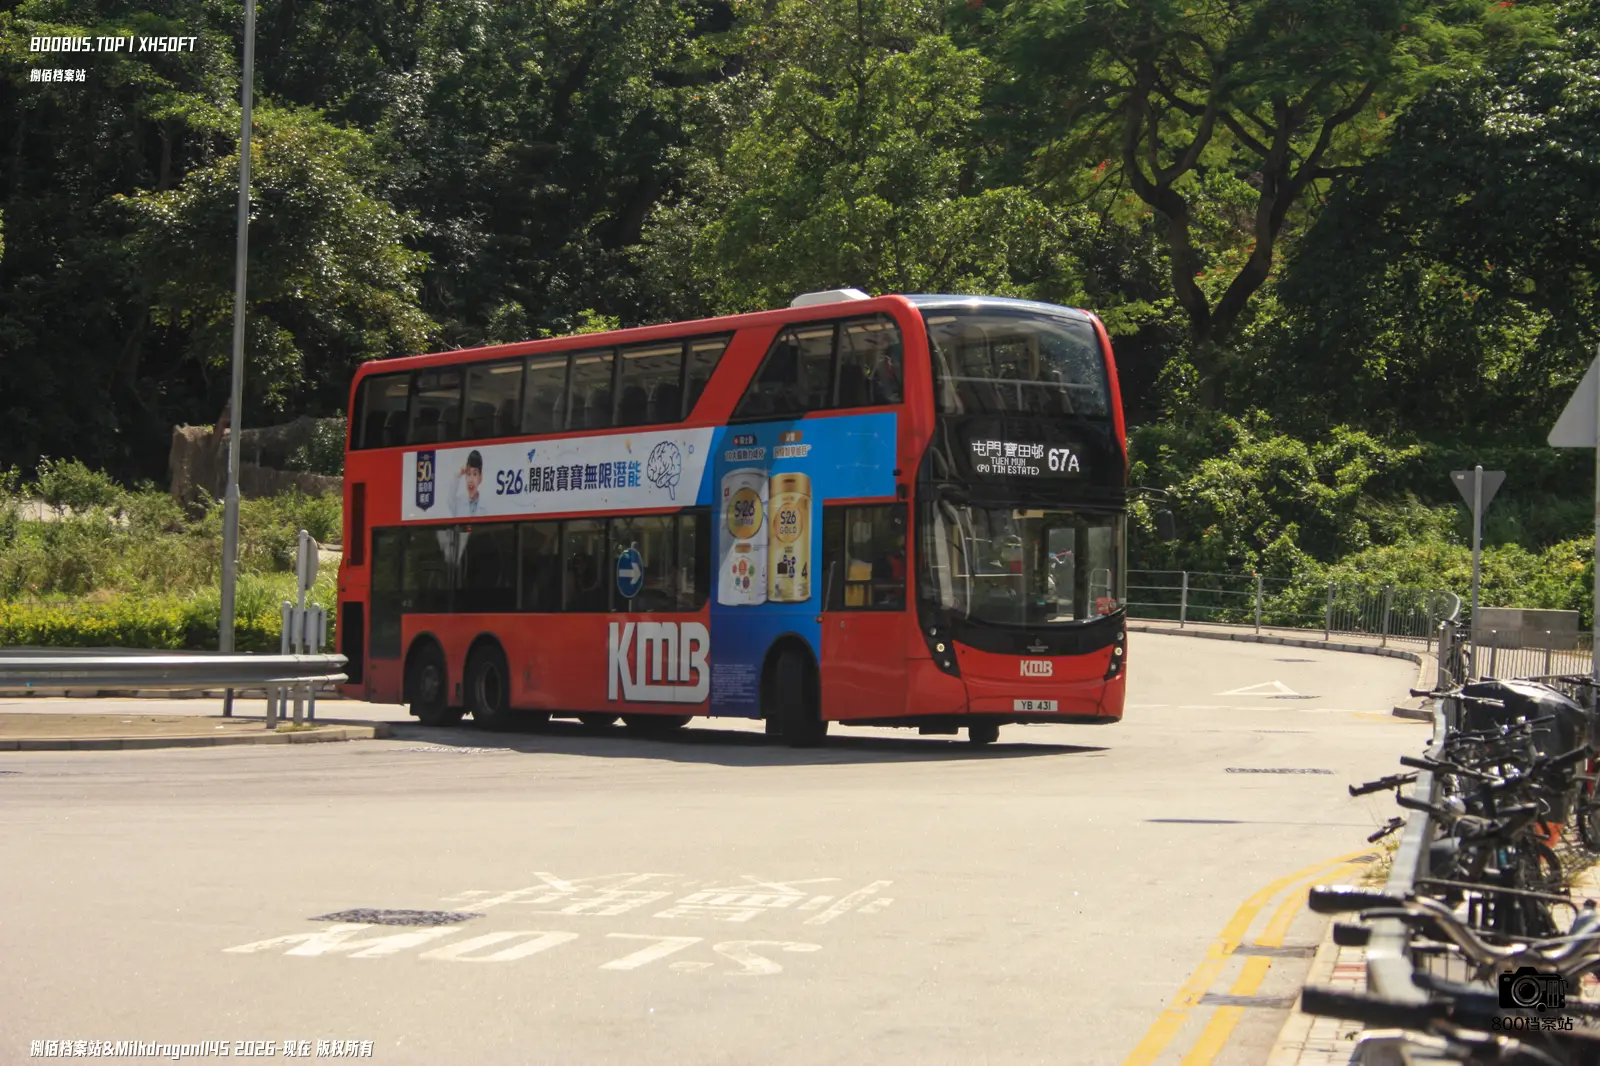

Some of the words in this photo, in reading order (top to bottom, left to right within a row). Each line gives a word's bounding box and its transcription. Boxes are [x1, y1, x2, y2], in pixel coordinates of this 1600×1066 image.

[991, 456, 1009, 466] TUEN
[1011, 458, 1026, 467] MUN
[1048, 448, 1080, 473] 67A
[417, 460, 432, 482] 50
[977, 465, 990, 473] (PO
[993, 465, 1006, 474] TIN
[1008, 466, 1040, 475] ESTATE)
[780, 526, 797, 534] GOLD
[801, 562, 808, 580] 4
[608, 622, 710, 703] KMB
[1020, 660, 1053, 677] KMB
[1021, 700, 1033, 710] YB
[1037, 700, 1051, 710] 431
[221, 923, 823, 976] SLOW
